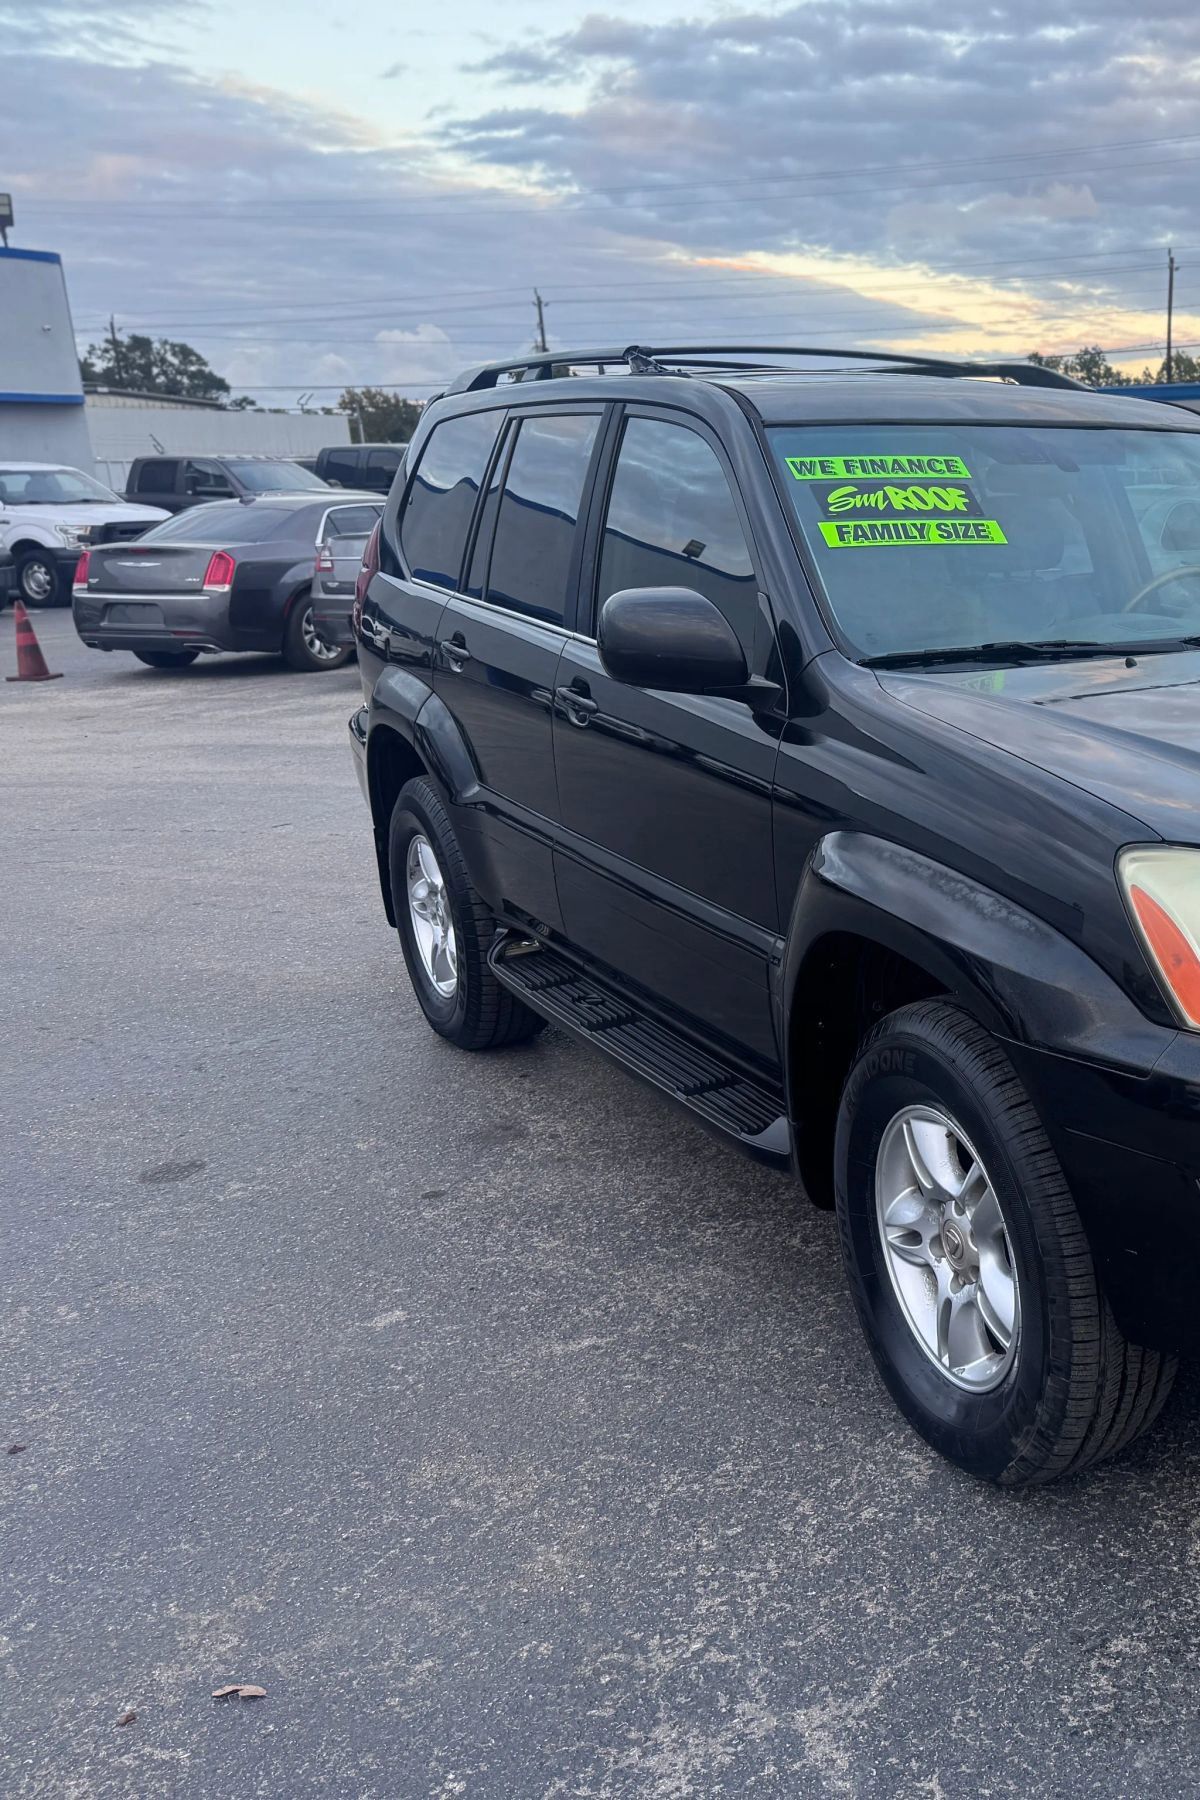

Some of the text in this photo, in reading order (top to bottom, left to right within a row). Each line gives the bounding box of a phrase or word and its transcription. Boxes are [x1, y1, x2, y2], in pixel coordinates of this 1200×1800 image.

[790, 458, 961, 476] WE FINANCE
[835, 522, 994, 543] FAMILY SIZE
